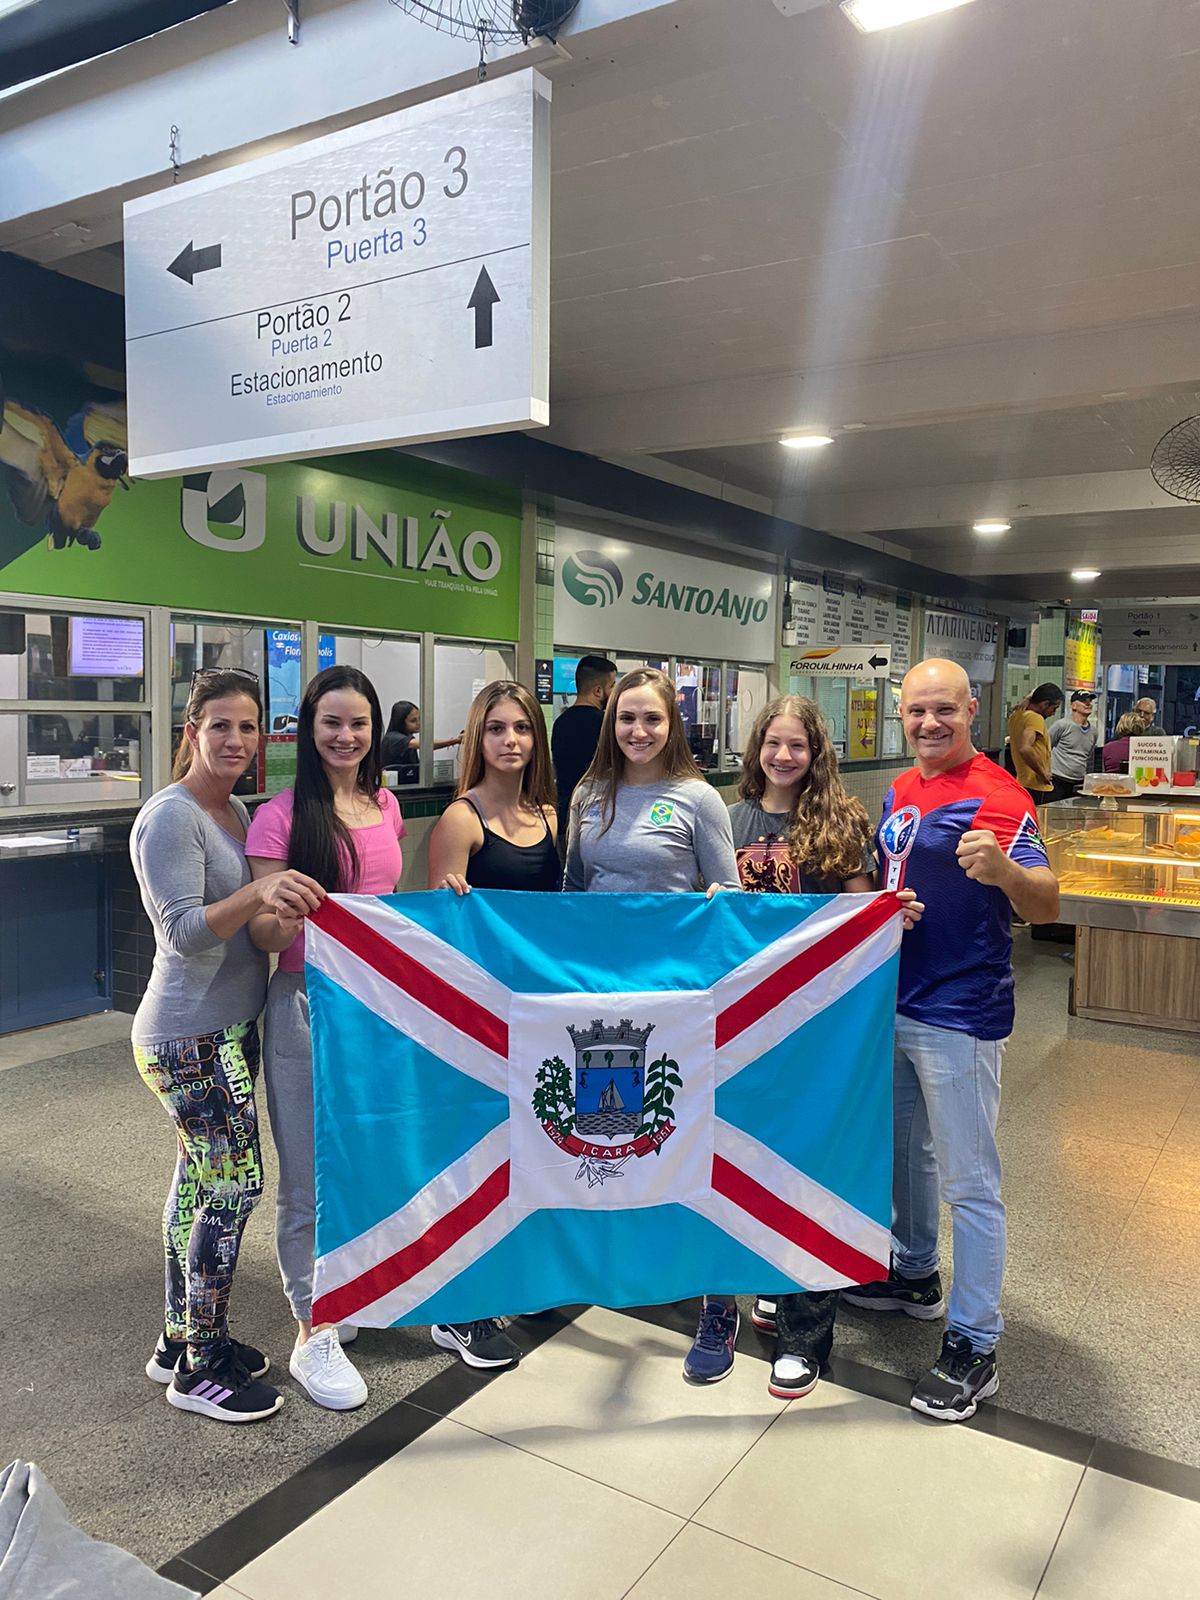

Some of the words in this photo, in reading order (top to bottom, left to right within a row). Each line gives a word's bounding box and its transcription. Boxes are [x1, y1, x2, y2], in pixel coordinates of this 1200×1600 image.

[290, 166, 426, 241] Portão
[443, 145, 469, 199] 3
[327, 228, 404, 269] Puerta
[413, 217, 428, 246] 3
[256, 302, 330, 340] Portão
[338, 293, 352, 321] 2
[271, 332, 319, 357] Puerta
[324, 328, 333, 347] 2
[230, 349, 383, 397] Estacionamento
[266, 383, 343, 406] Estacionamiento
[299, 495, 502, 583] UNIÃO
[272, 631, 298, 641] Caxias
[789, 660, 864, 671] FORQUILHINHA
[171, 1075, 214, 1096] sport
